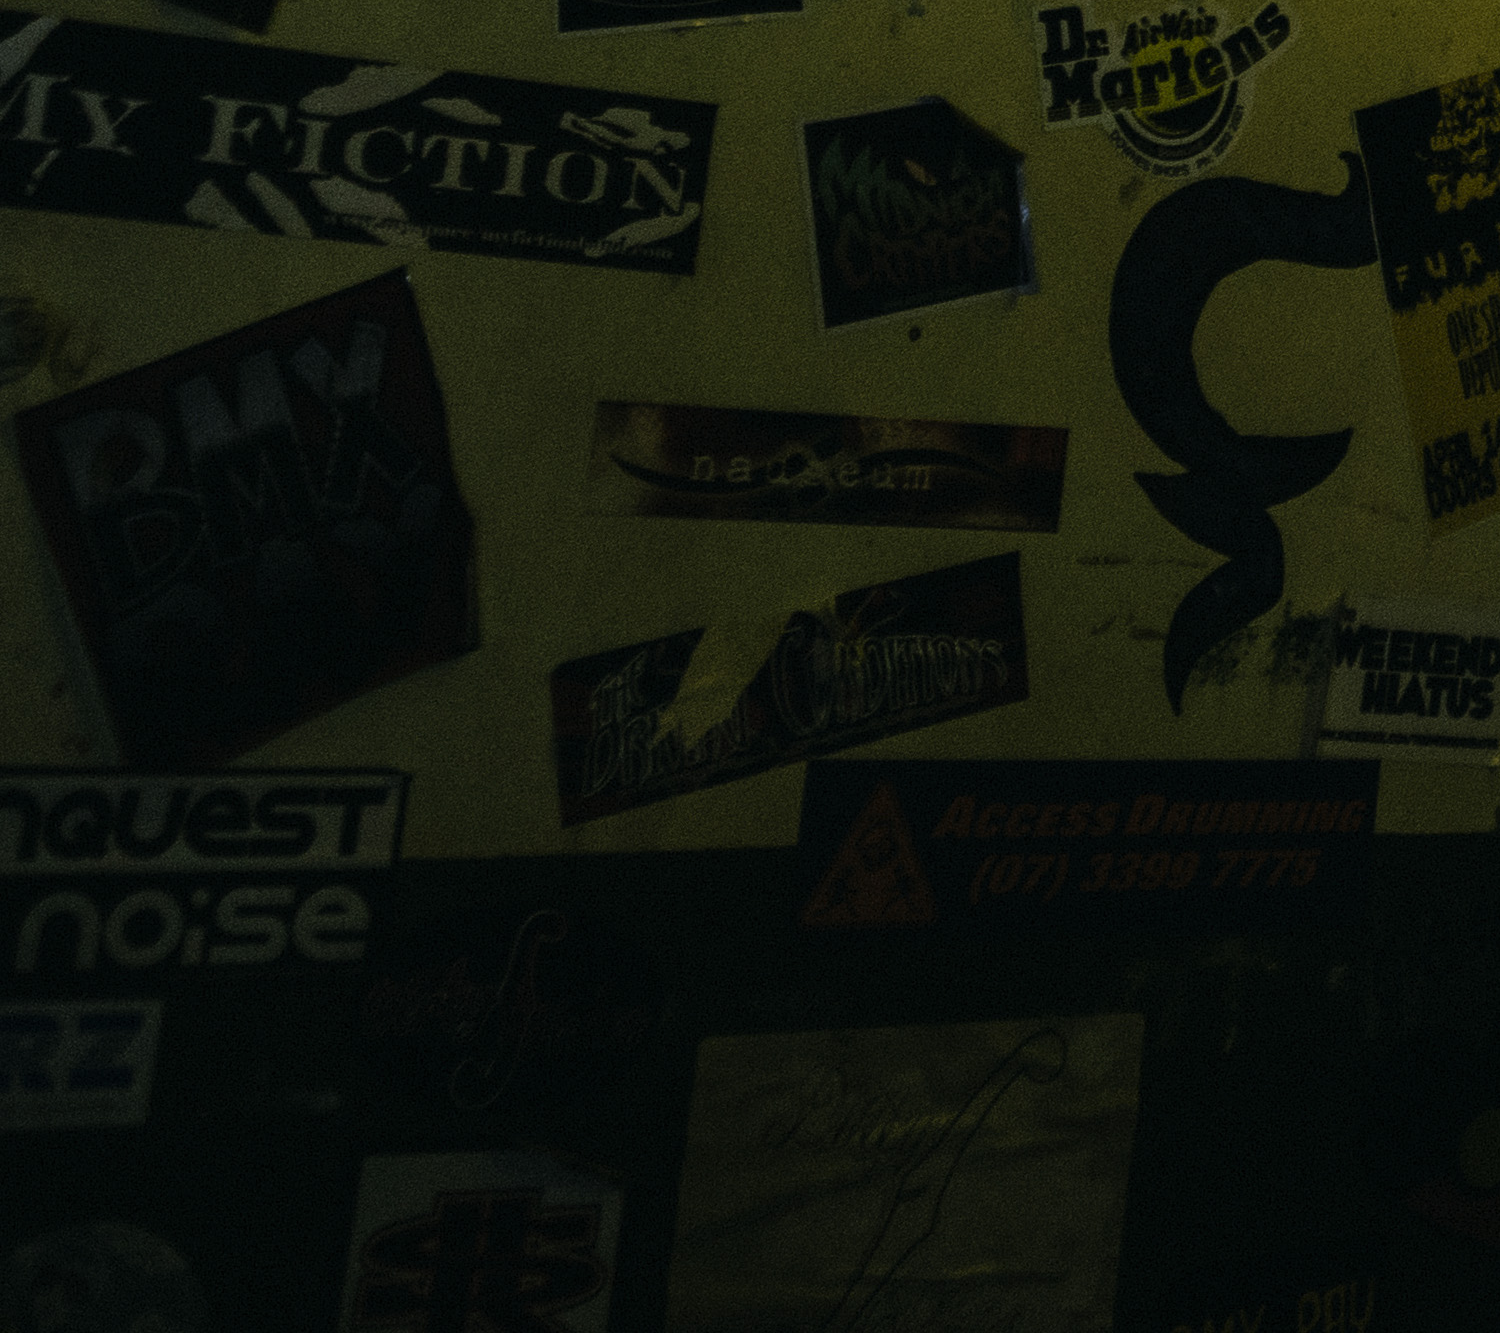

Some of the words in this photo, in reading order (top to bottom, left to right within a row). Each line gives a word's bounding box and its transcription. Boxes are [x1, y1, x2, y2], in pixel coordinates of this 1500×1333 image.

[1044, 1, 1292, 125] Martens
[199, 94, 690, 218] FICTION
[1361, 671, 1494, 721] HIATUS
[931, 793, 1123, 839] ACCESS
[1124, 793, 1368, 838] DRUMMING
[969, 852, 1072, 905] (07)
[13, 883, 372, 974] noise
